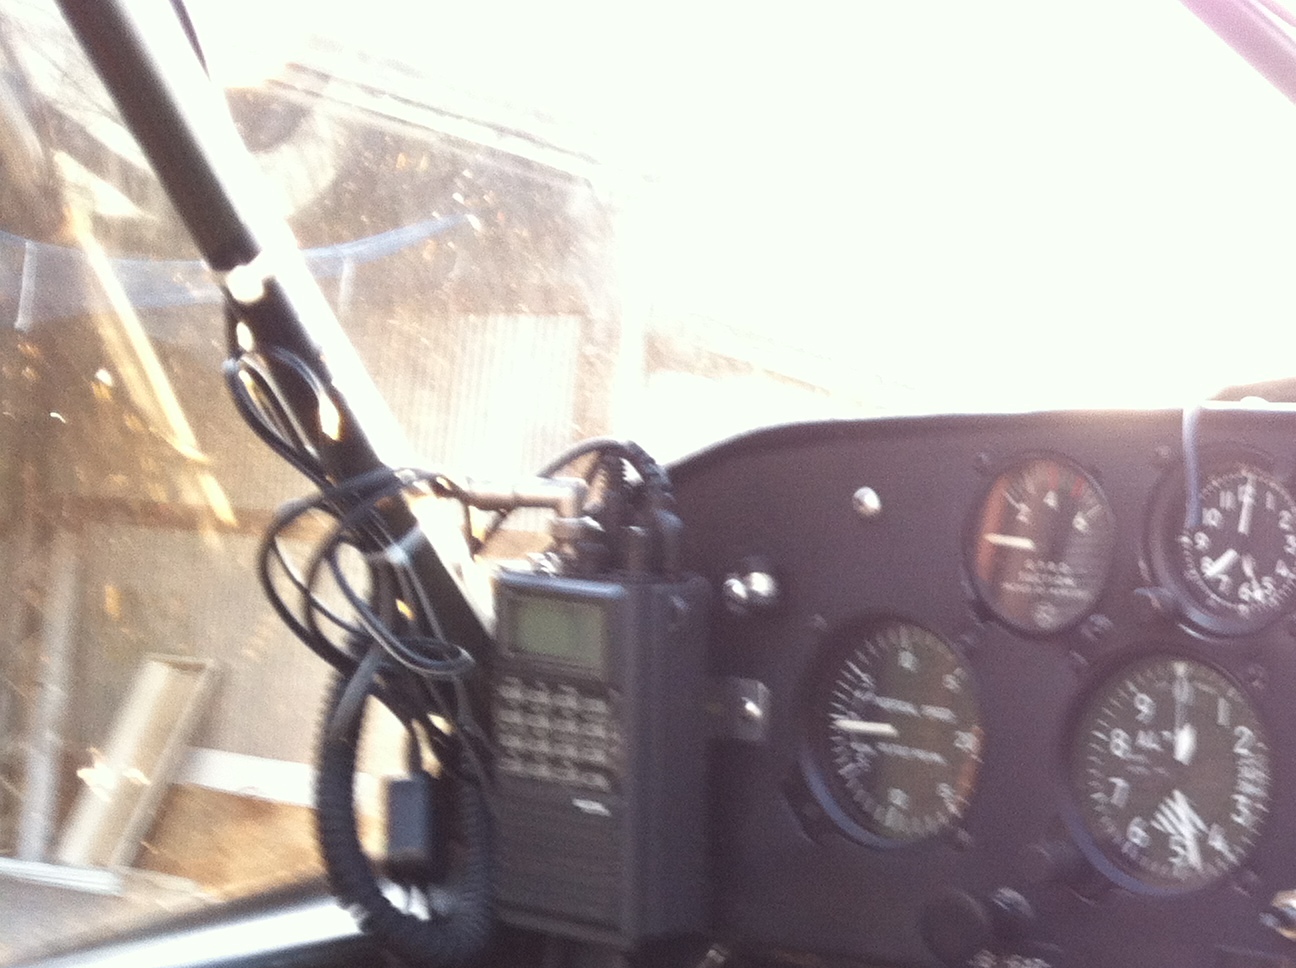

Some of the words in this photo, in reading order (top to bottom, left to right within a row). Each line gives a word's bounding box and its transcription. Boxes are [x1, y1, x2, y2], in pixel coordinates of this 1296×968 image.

[1202, 508, 1223, 527] 10
[1279, 510, 1293, 530] 2
[1194, 532, 1209, 550] 9
[1134, 693, 1156, 723] 9
[1217, 698, 1231, 724] 1
[1110, 728, 1131, 758] 8
[1234, 725, 1254, 755] 2
[1109, 777, 1130, 807] 7
[1127, 817, 1150, 847] 6
